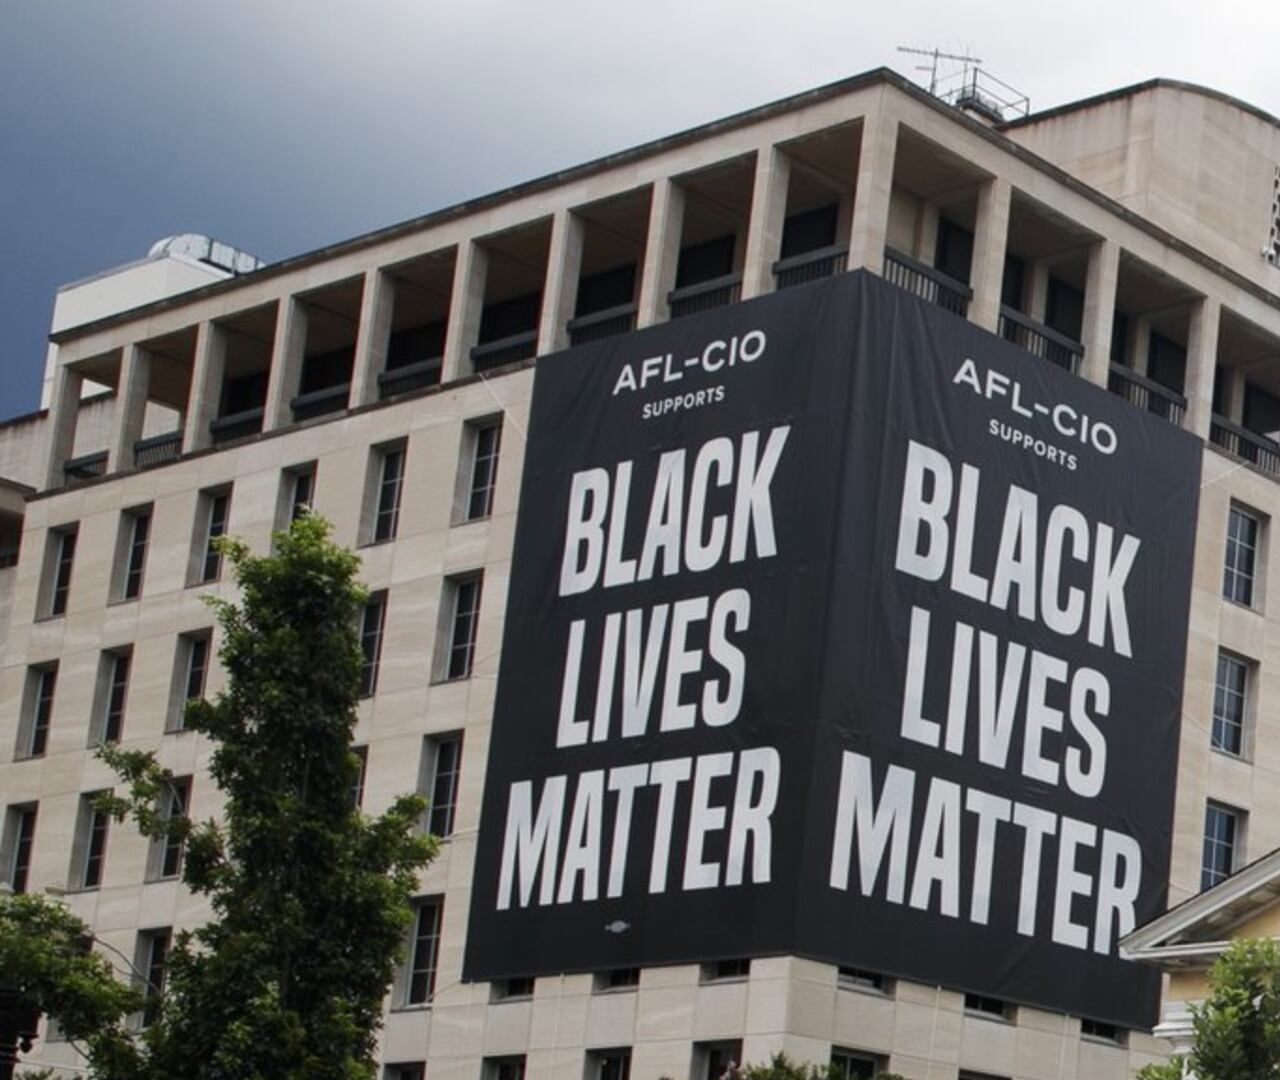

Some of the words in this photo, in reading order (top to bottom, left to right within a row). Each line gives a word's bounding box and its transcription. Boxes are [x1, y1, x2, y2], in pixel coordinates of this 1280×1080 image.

[612, 330, 767, 396] AFL-CIO
[642, 385, 726, 420] SUPPORTS
[952, 358, 1119, 456] AFL-CIO
[559, 425, 790, 597] BLACK
[988, 419, 1078, 471] SUPPORTS
[895, 441, 1141, 658] BLACK
[556, 589, 751, 748] LIVES
[900, 606, 1110, 798] LIVES
[496, 746, 781, 911] MATTER
[829, 750, 1142, 959] MATTER
